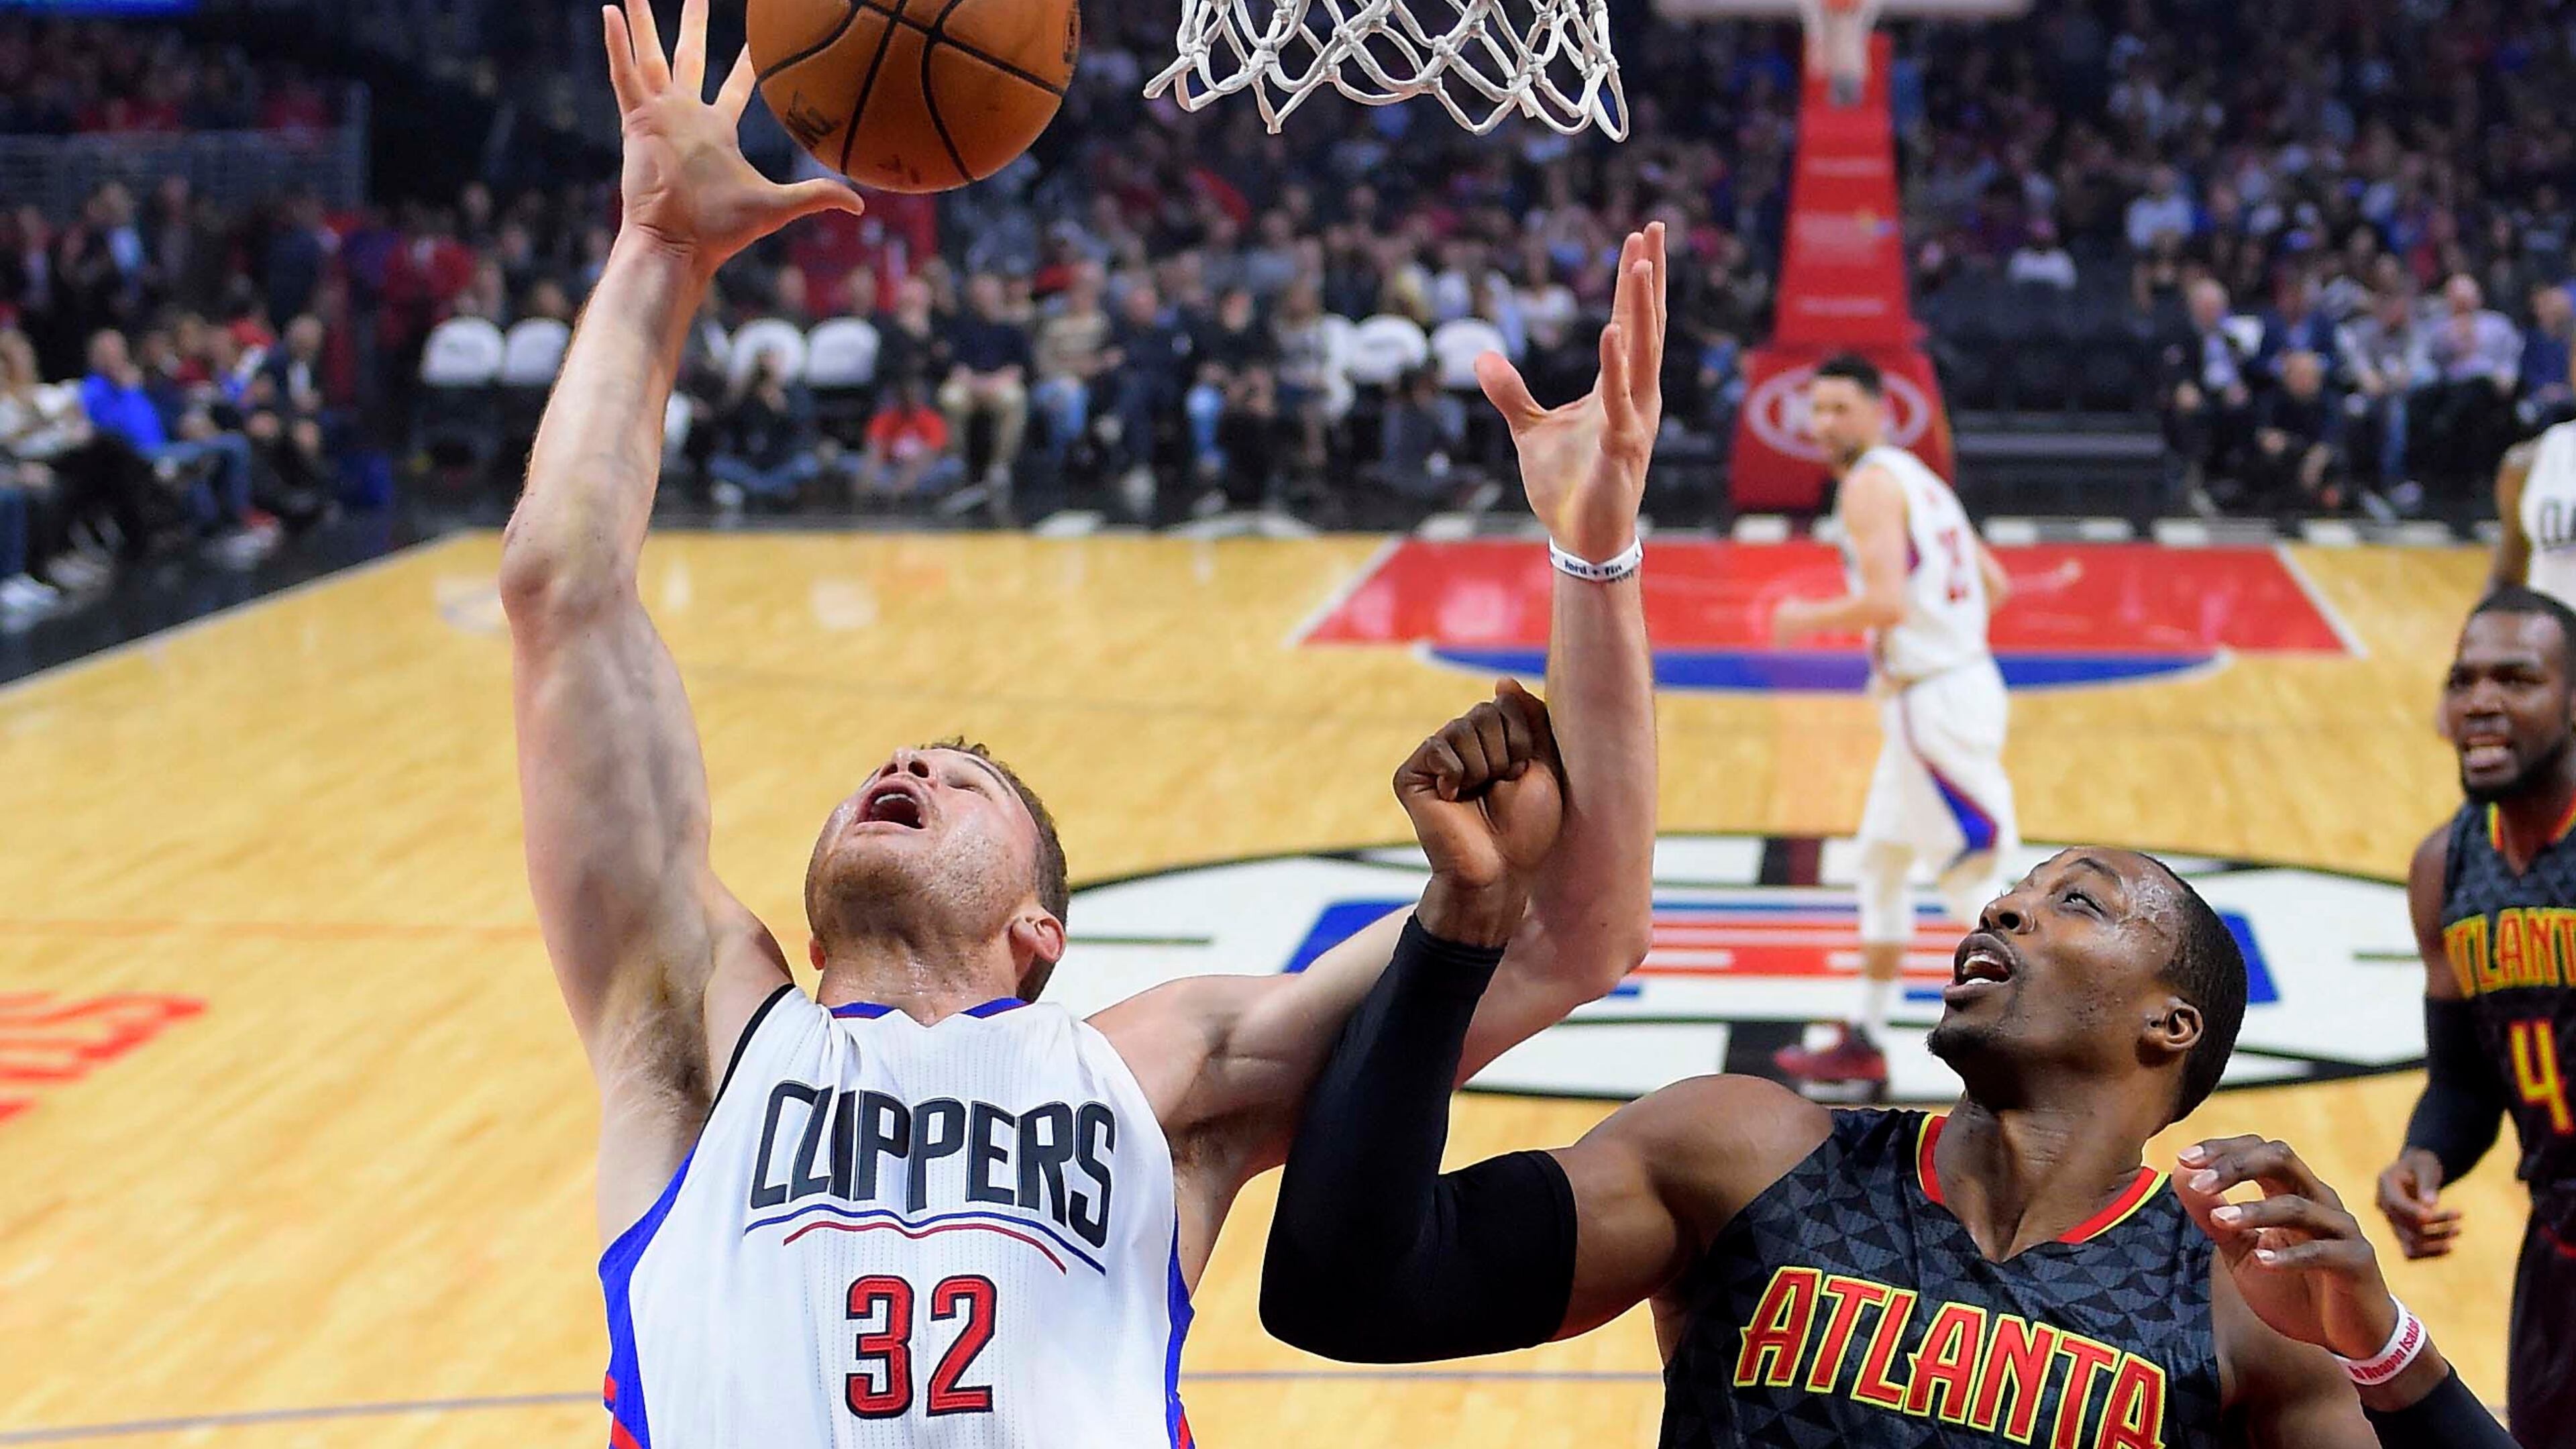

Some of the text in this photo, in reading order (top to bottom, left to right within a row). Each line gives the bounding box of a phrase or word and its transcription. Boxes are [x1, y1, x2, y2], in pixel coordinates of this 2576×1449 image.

[2509, 1017, 2573, 1135] 4
[750, 1079, 1115, 1248] CLIPPERS
[845, 1274, 998, 1419] 32
[1733, 1265, 2167, 1449] ATLANTA
[2359, 1347, 2407, 1380] Weapon
